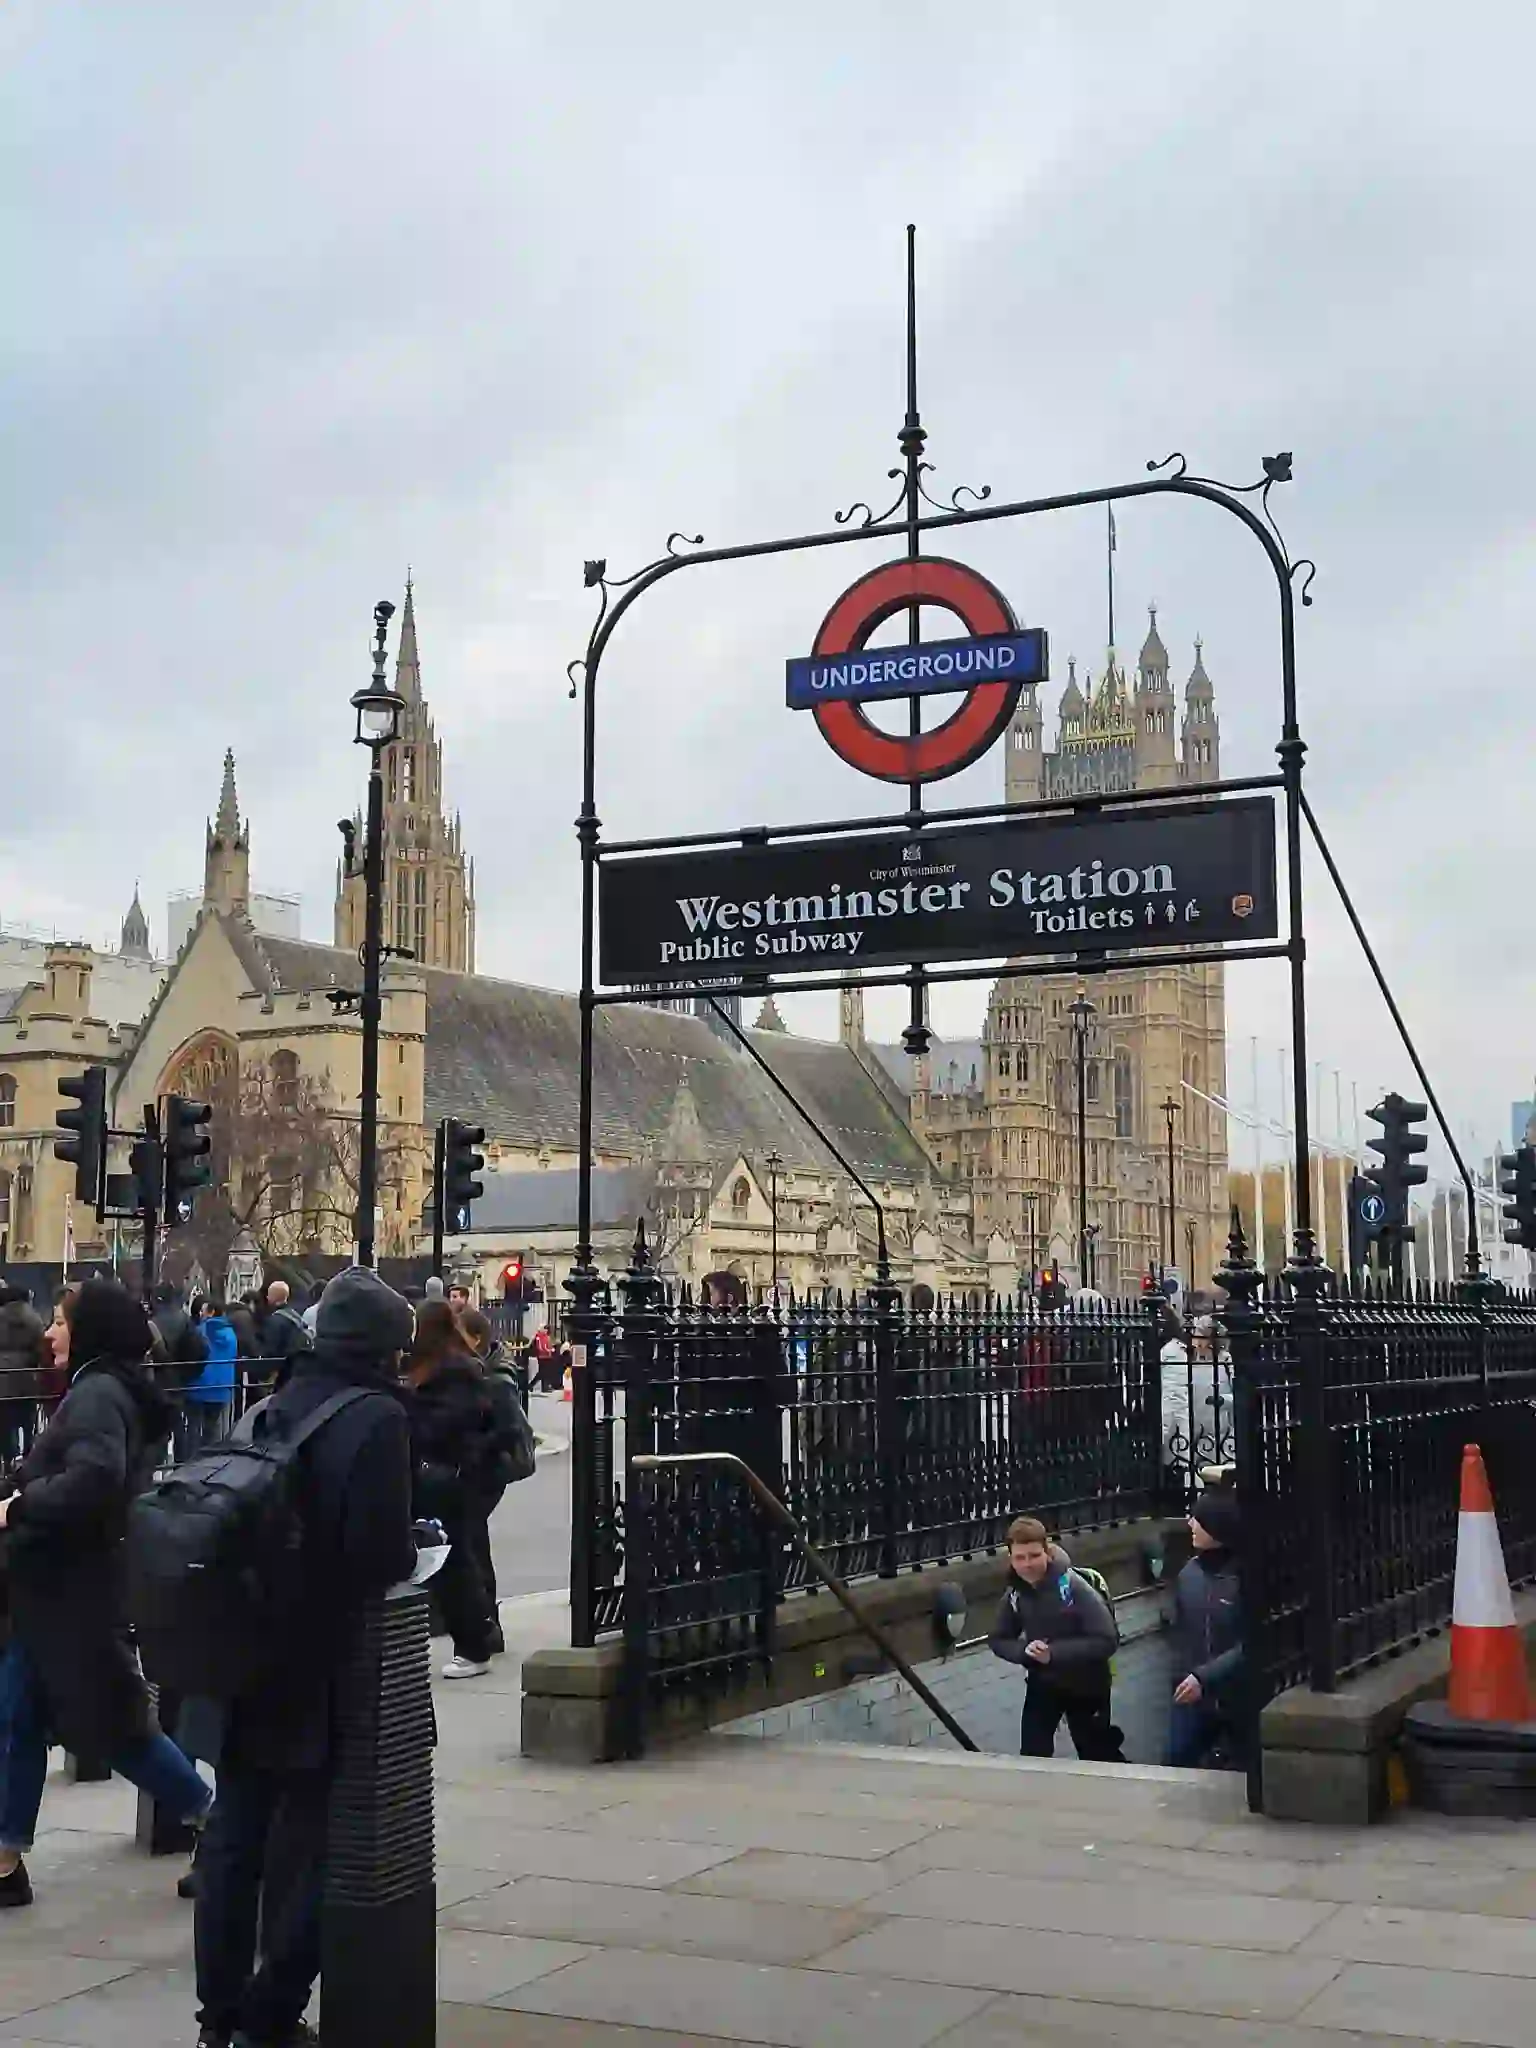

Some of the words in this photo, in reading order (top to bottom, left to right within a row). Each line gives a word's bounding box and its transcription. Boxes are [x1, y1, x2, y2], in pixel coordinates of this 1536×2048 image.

[810, 646, 1016, 690] UNDERGROUND
[869, 867, 888, 881] City
[888, 866, 898, 879] of
[675, 879, 972, 934] Westminster
[988, 860, 1177, 908] Station
[1029, 904, 1135, 935] Toilets
[659, 935, 745, 964] Public
[755, 928, 864, 956] Subway
